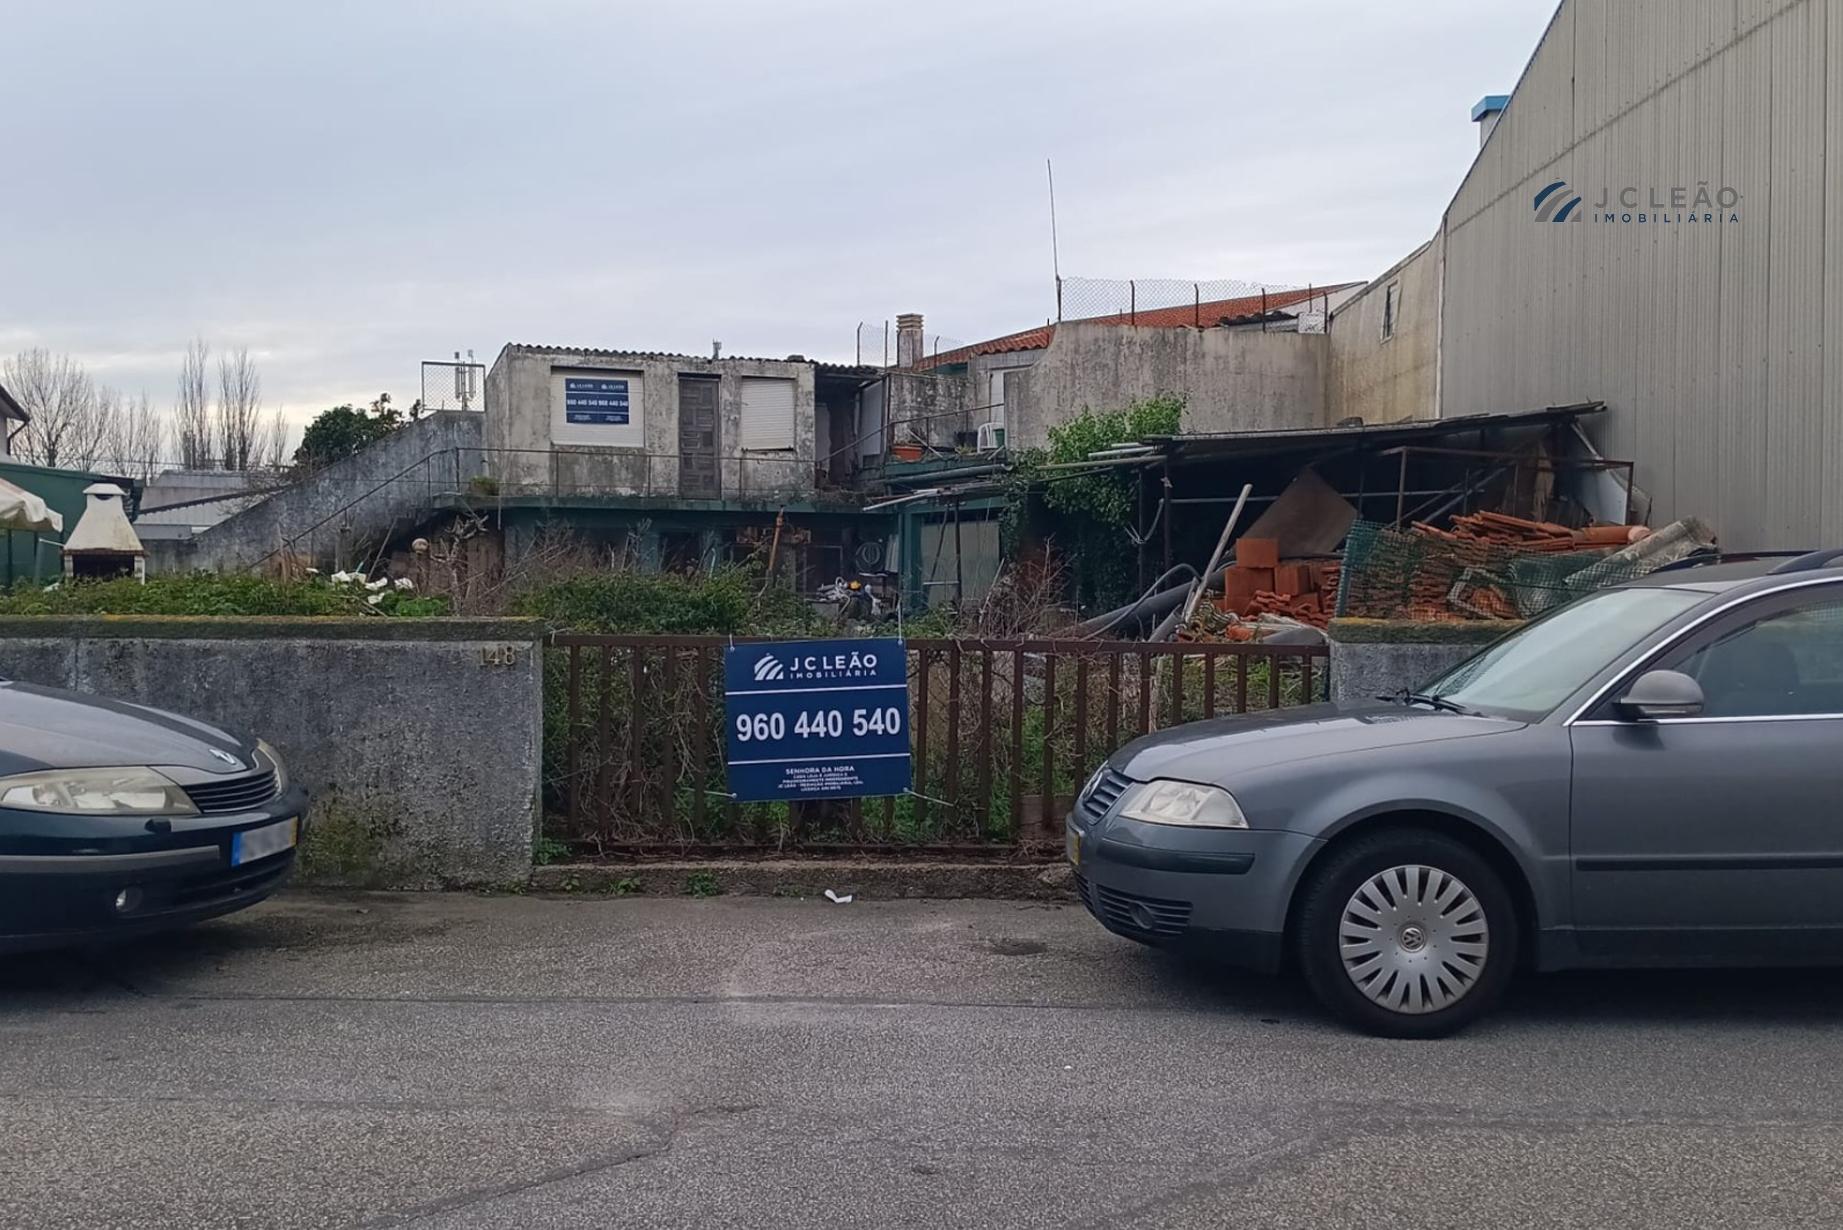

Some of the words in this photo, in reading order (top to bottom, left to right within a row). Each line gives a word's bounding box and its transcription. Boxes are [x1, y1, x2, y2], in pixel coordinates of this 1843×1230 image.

[480, 646, 516, 666] 148
[790, 669, 877, 680] IMOBILIÁRIA
[736, 712, 785, 742] 960
[794, 709, 843, 739] 440
[852, 707, 901, 736] 540
[786, 767, 820, 775] SENHORA
